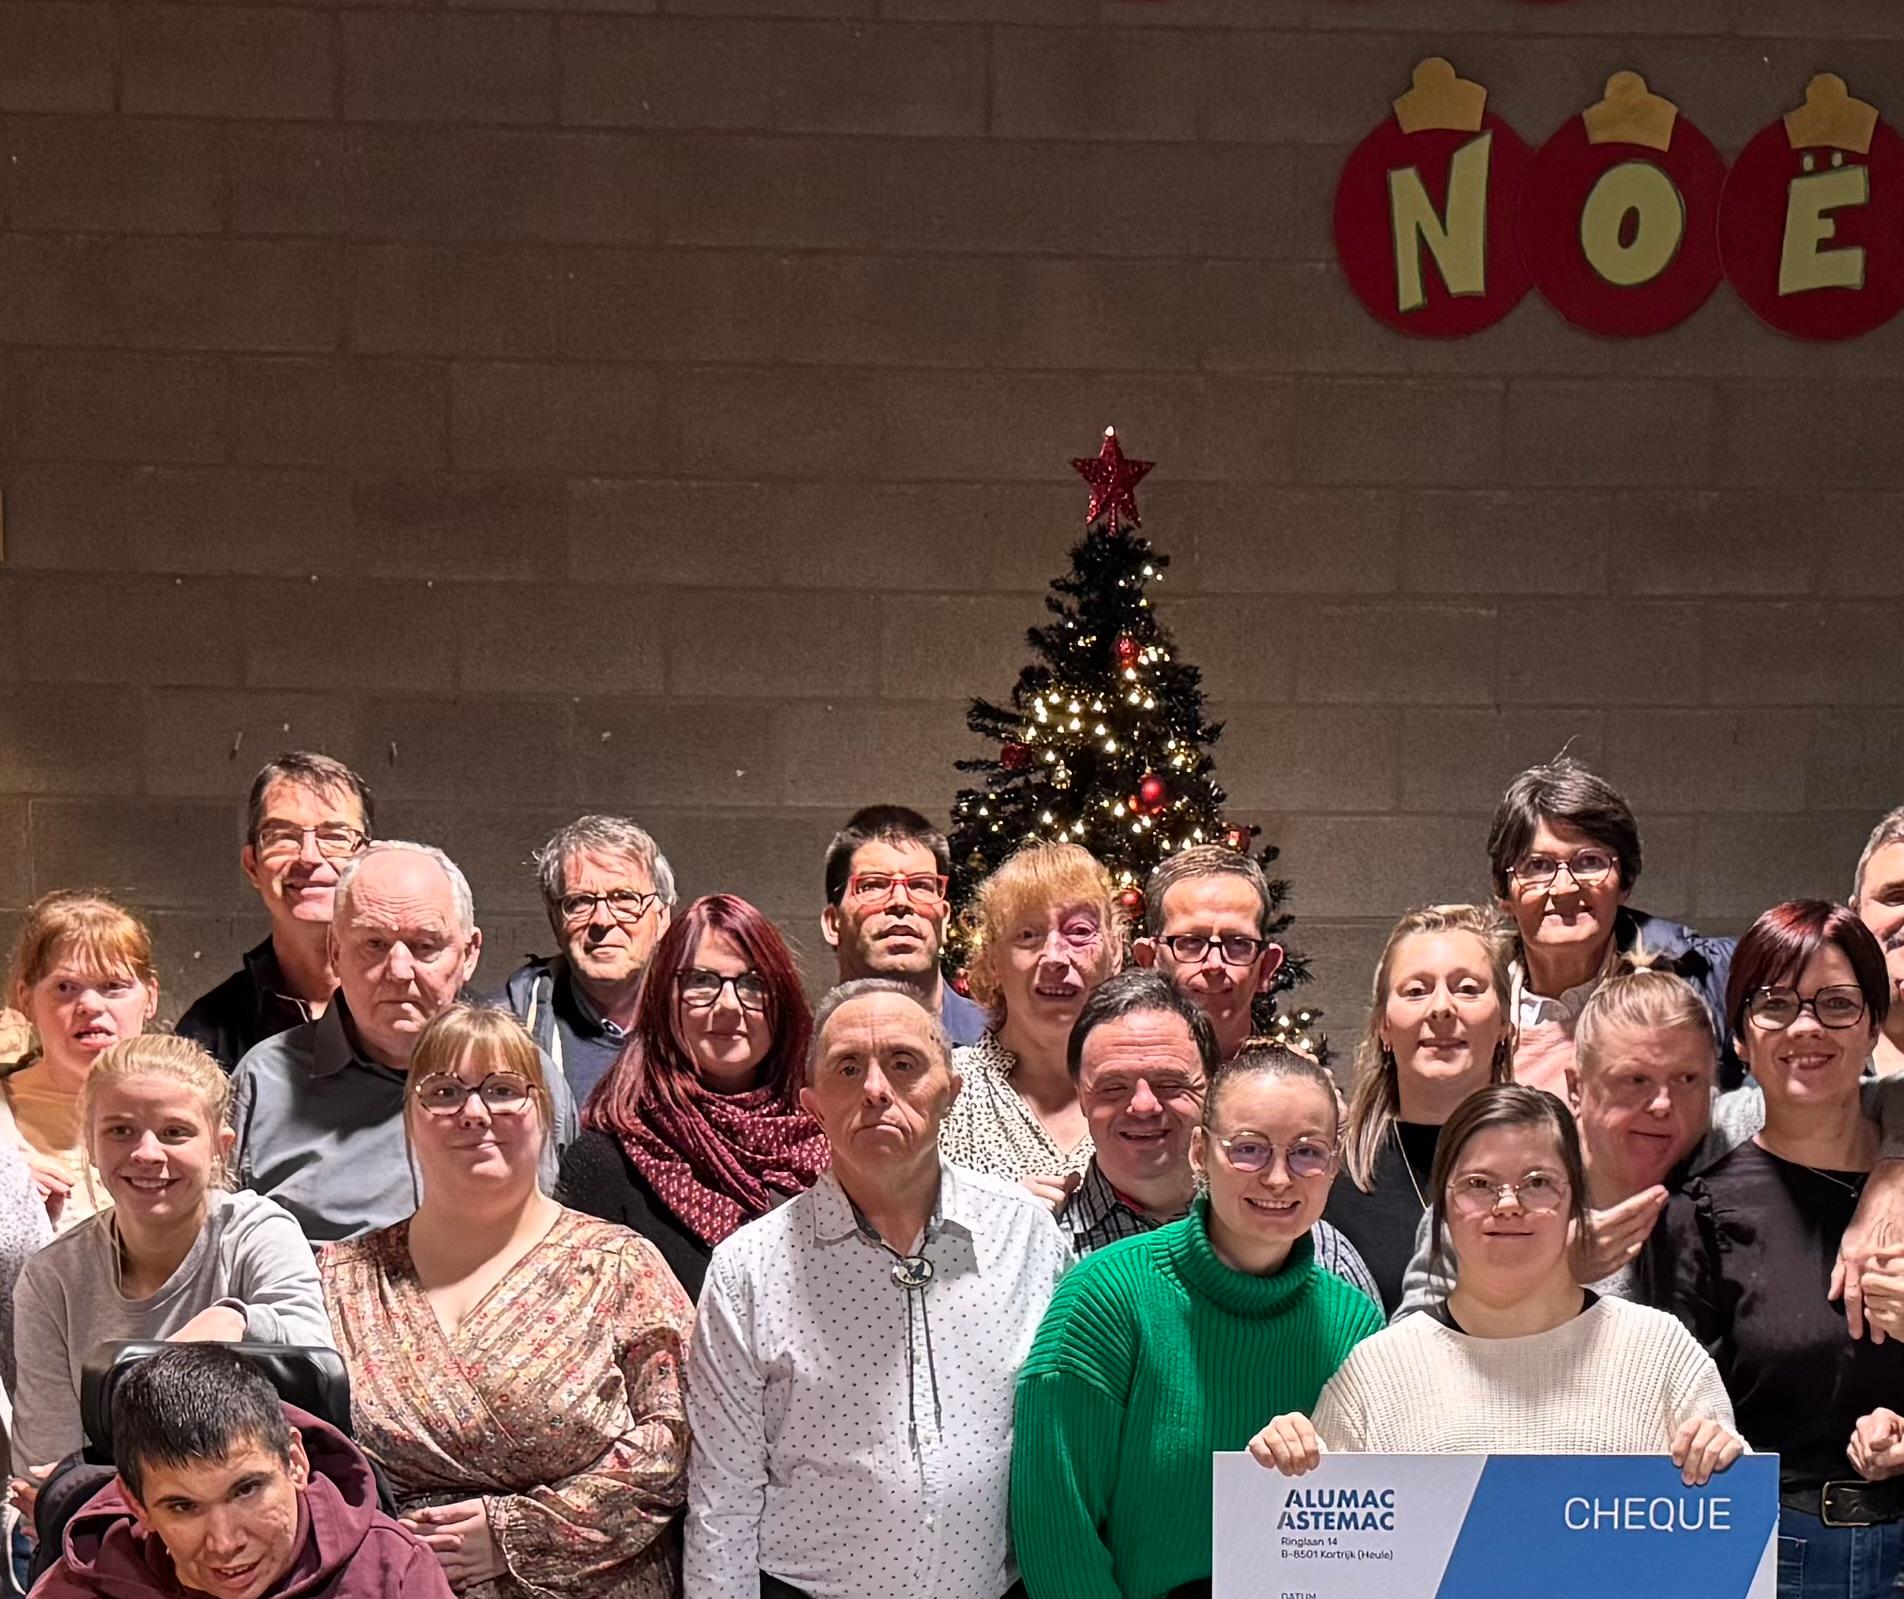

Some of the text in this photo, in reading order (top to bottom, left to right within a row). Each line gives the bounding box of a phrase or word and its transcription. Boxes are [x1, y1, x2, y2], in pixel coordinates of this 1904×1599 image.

[1285, 1489, 1395, 1508] ALUMAC
[1276, 1511, 1394, 1530] ASTEMAC
[1564, 1497, 1731, 1532] CHEQUE
[1281, 1537, 1338, 1548] Ringlaan 14
[1281, 1550, 1318, 1559] B-8501
[1320, 1550, 1355, 1561] Kortrijk
